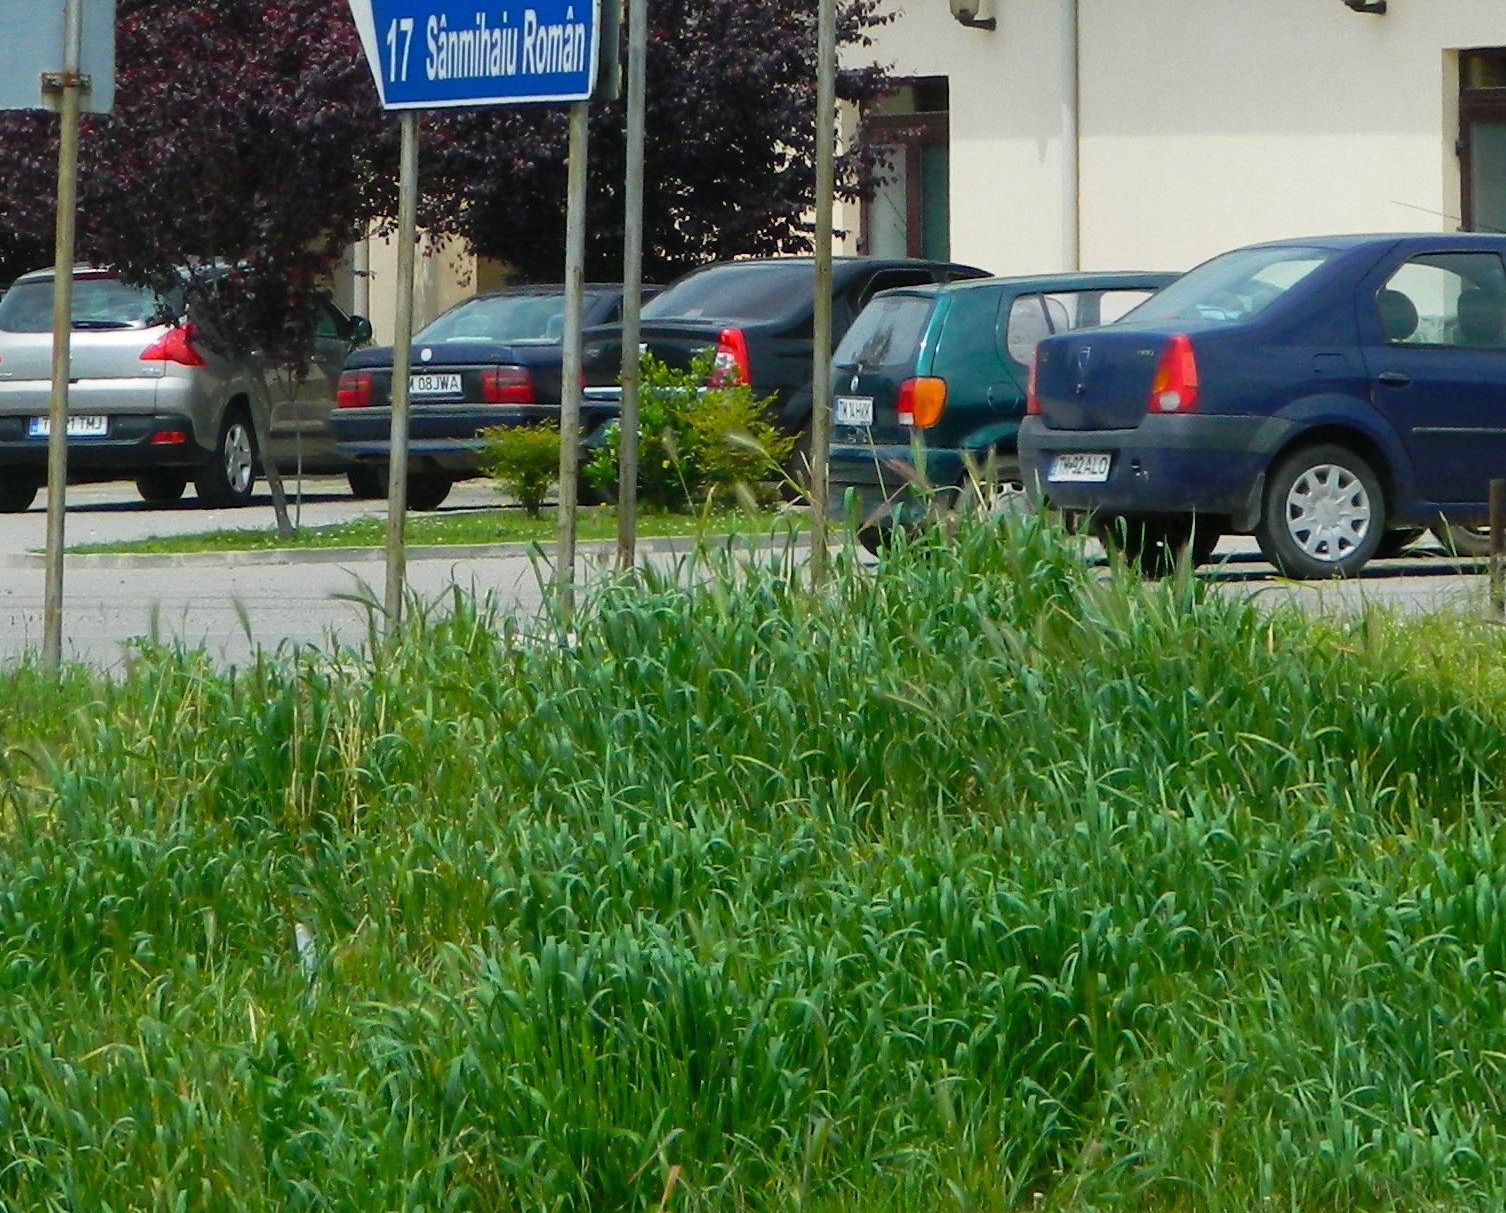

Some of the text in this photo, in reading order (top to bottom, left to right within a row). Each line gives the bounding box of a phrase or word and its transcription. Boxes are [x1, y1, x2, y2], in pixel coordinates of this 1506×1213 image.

[386, 5, 586, 82] 17 Sânmihaiu Român
